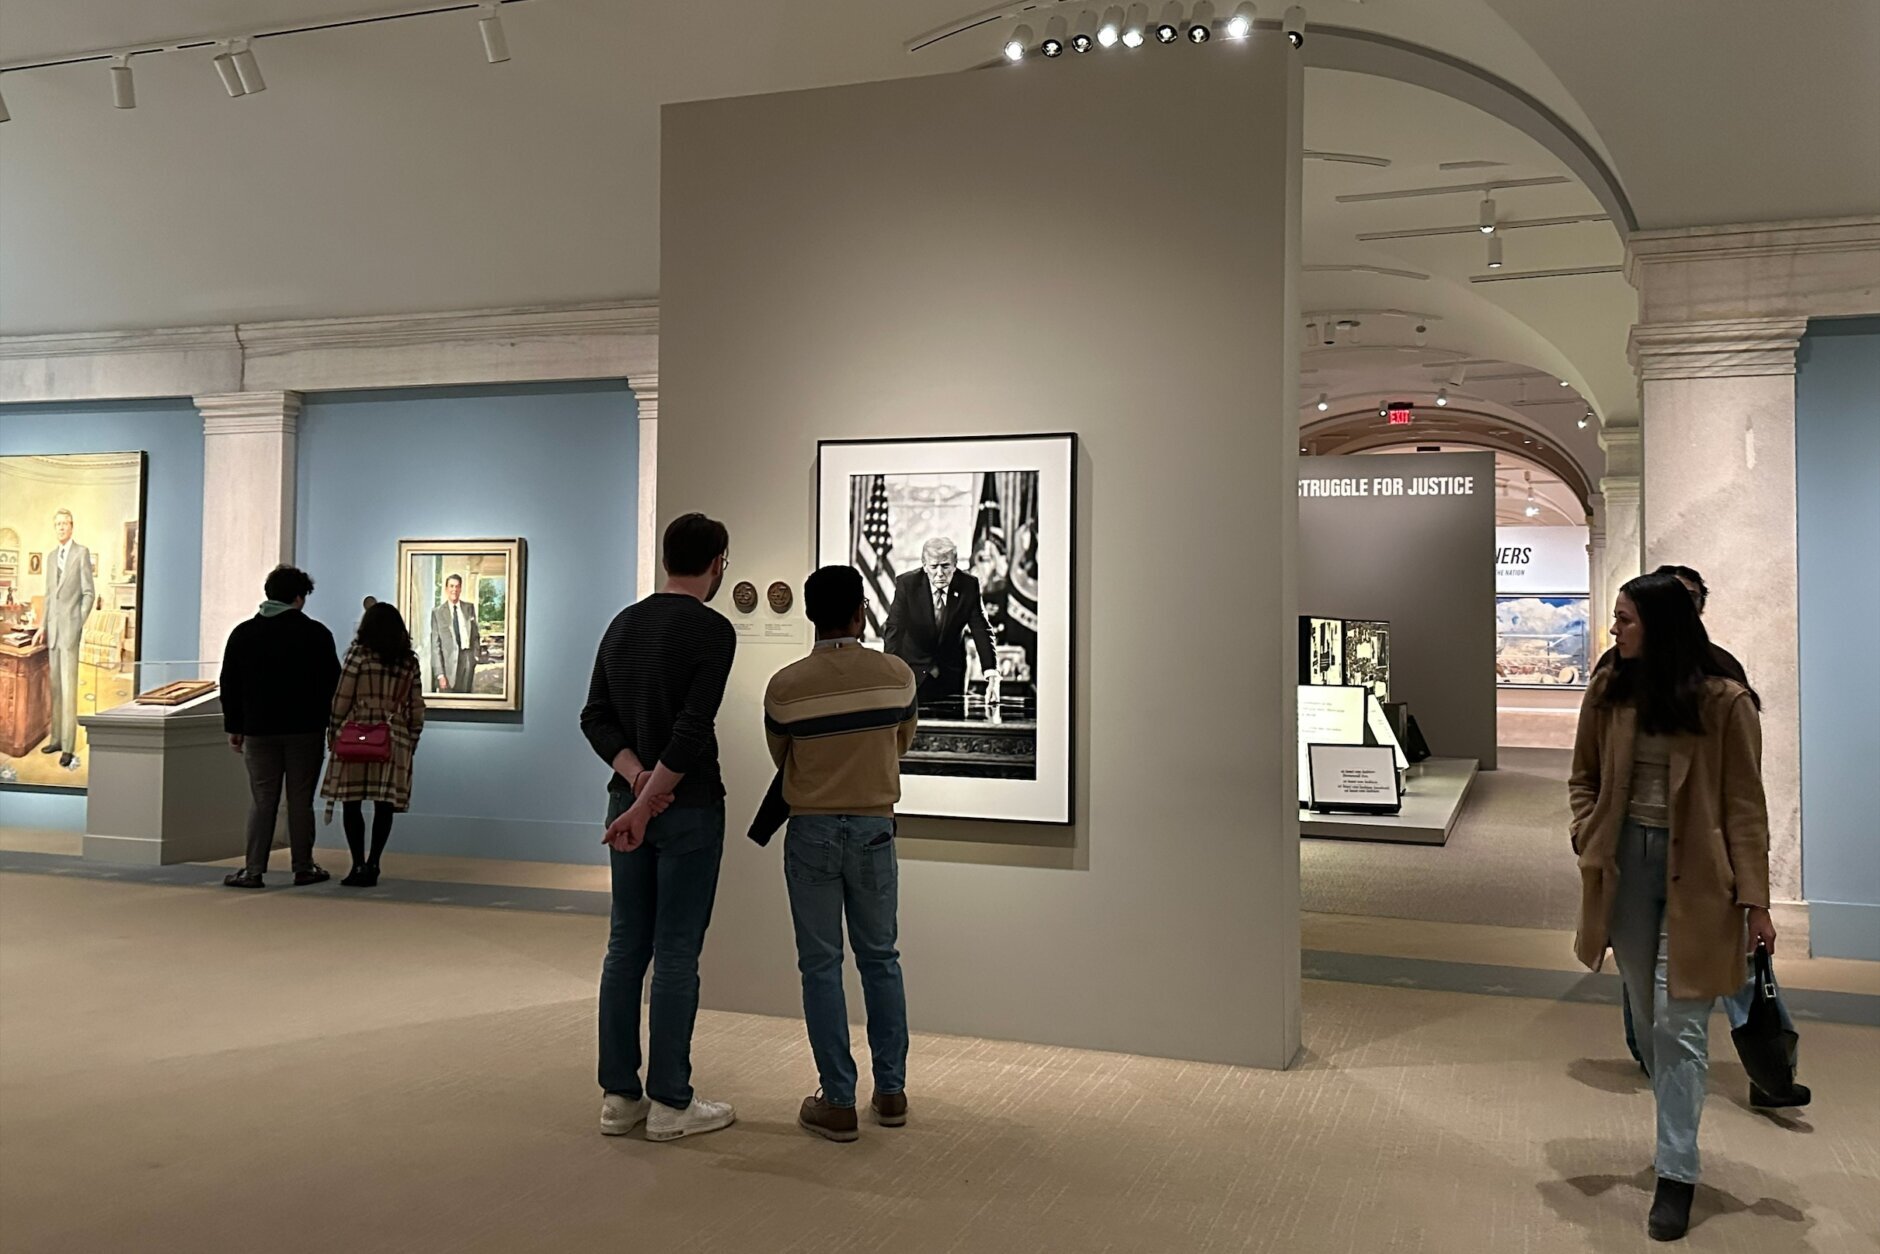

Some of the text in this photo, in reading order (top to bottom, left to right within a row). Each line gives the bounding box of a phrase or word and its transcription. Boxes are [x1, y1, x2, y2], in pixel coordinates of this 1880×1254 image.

[1390, 410, 1409, 424] EXIT
[1373, 478, 1403, 496] FOR
[1408, 476, 1474, 496] JUSTICE
